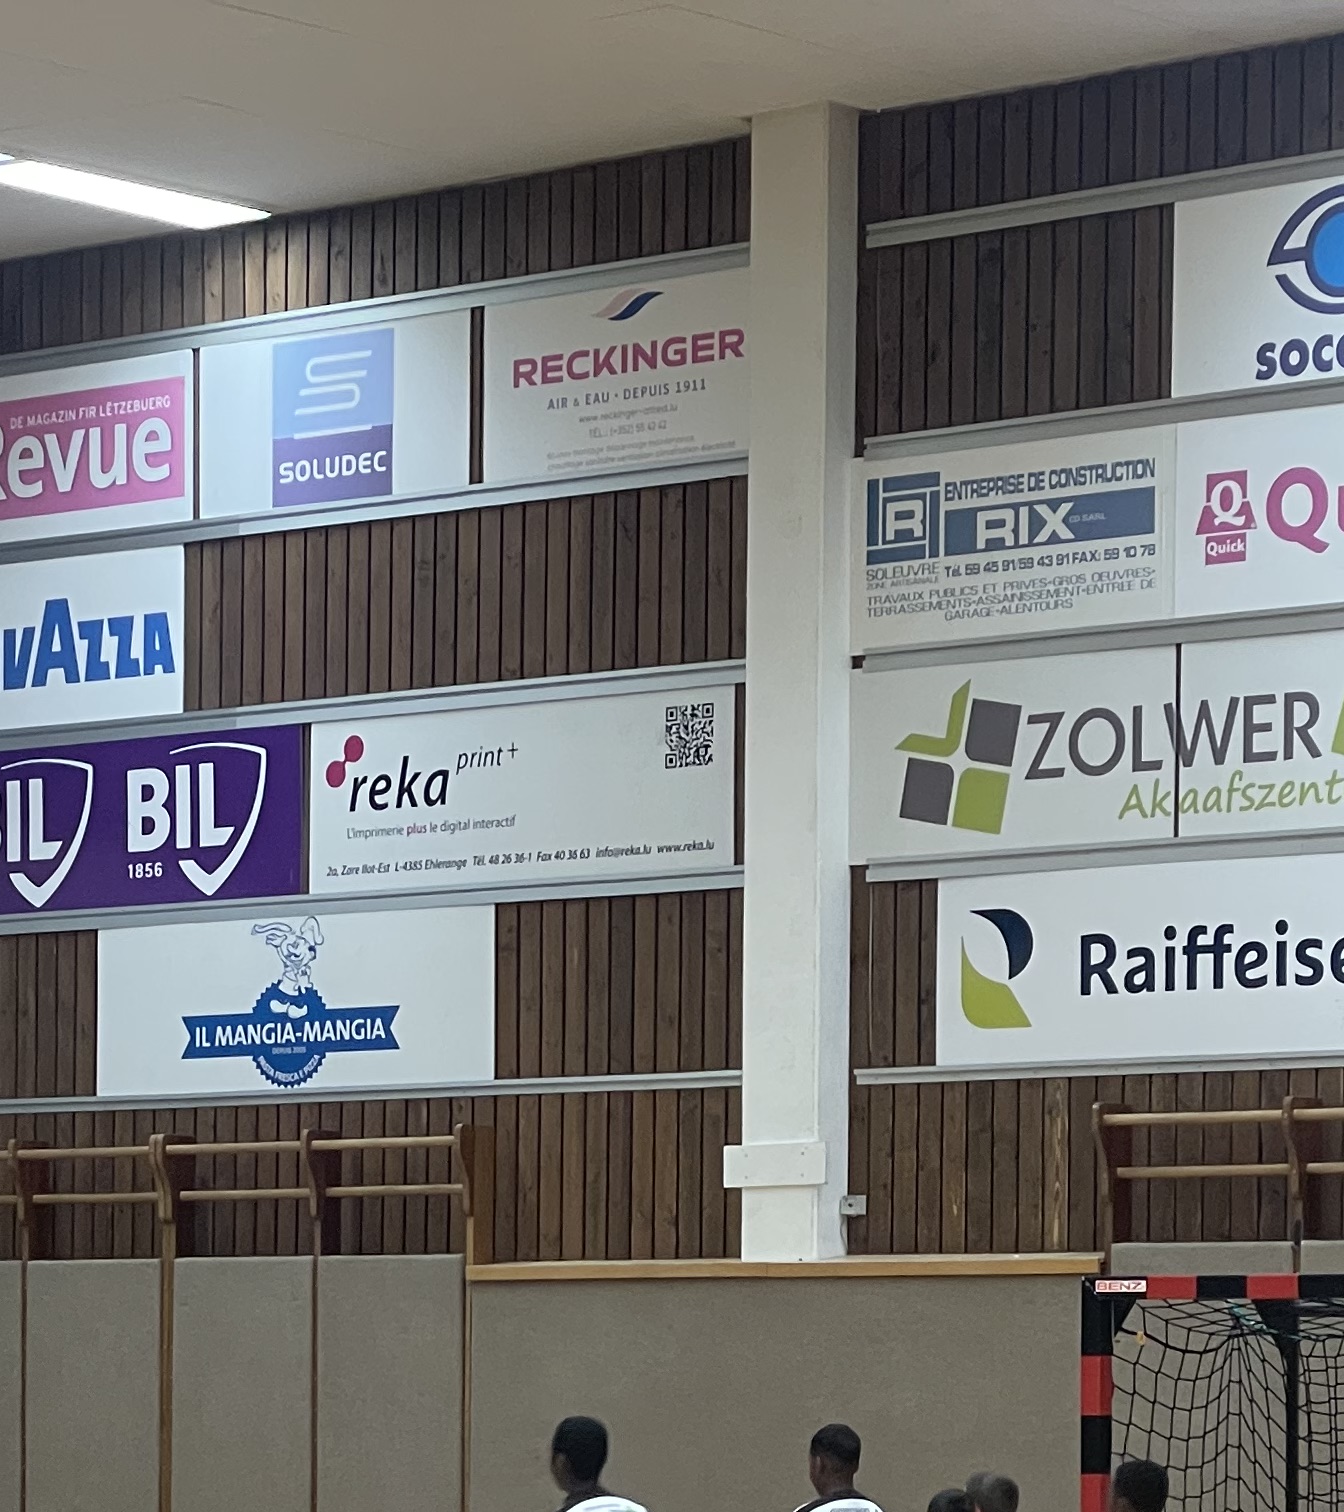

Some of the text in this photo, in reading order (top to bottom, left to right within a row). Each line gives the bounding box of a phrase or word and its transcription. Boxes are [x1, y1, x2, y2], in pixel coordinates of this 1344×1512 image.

[513, 328, 745, 388] RECKINGER
[547, 378, 706, 410] AIR & EAU DEPUIS 1911
[10, 416, 24, 430] DE
[26, 410, 76, 428] MAGAZIN
[79, 406, 97, 420] FIR
[279, 451, 387, 484] SOLUDEC
[945, 457, 1155, 502] ENTREPRISE DE CONSTRUCTION
[976, 502, 1075, 550] RIX
[1037, 555, 1053, 567] 43
[1056, 553, 1070, 566] 91
[1123, 546, 1137, 558] 10
[1207, 538, 1245, 557] Quick
[866, 561, 940, 582] SOLEUVRE
[867, 591, 924, 606] TRAVAUX
[929, 585, 978, 600] PUBLICS
[983, 583, 998, 594] ET
[349, 755, 450, 812] reka
[126, 762, 235, 853] BIL
[347, 814, 517, 840] L'imprimerie plus le digital interactif
[489, 854, 500, 865] 48
[536, 851, 552, 863] Fax
[554, 850, 565, 861] 40
[657, 839, 715, 854] www.reka.lu
[127, 862, 163, 879] 1856
[195, 1018, 386, 1048] IL MANGIA-MANGIA
[1096, 1281, 1143, 1291] BENZ
